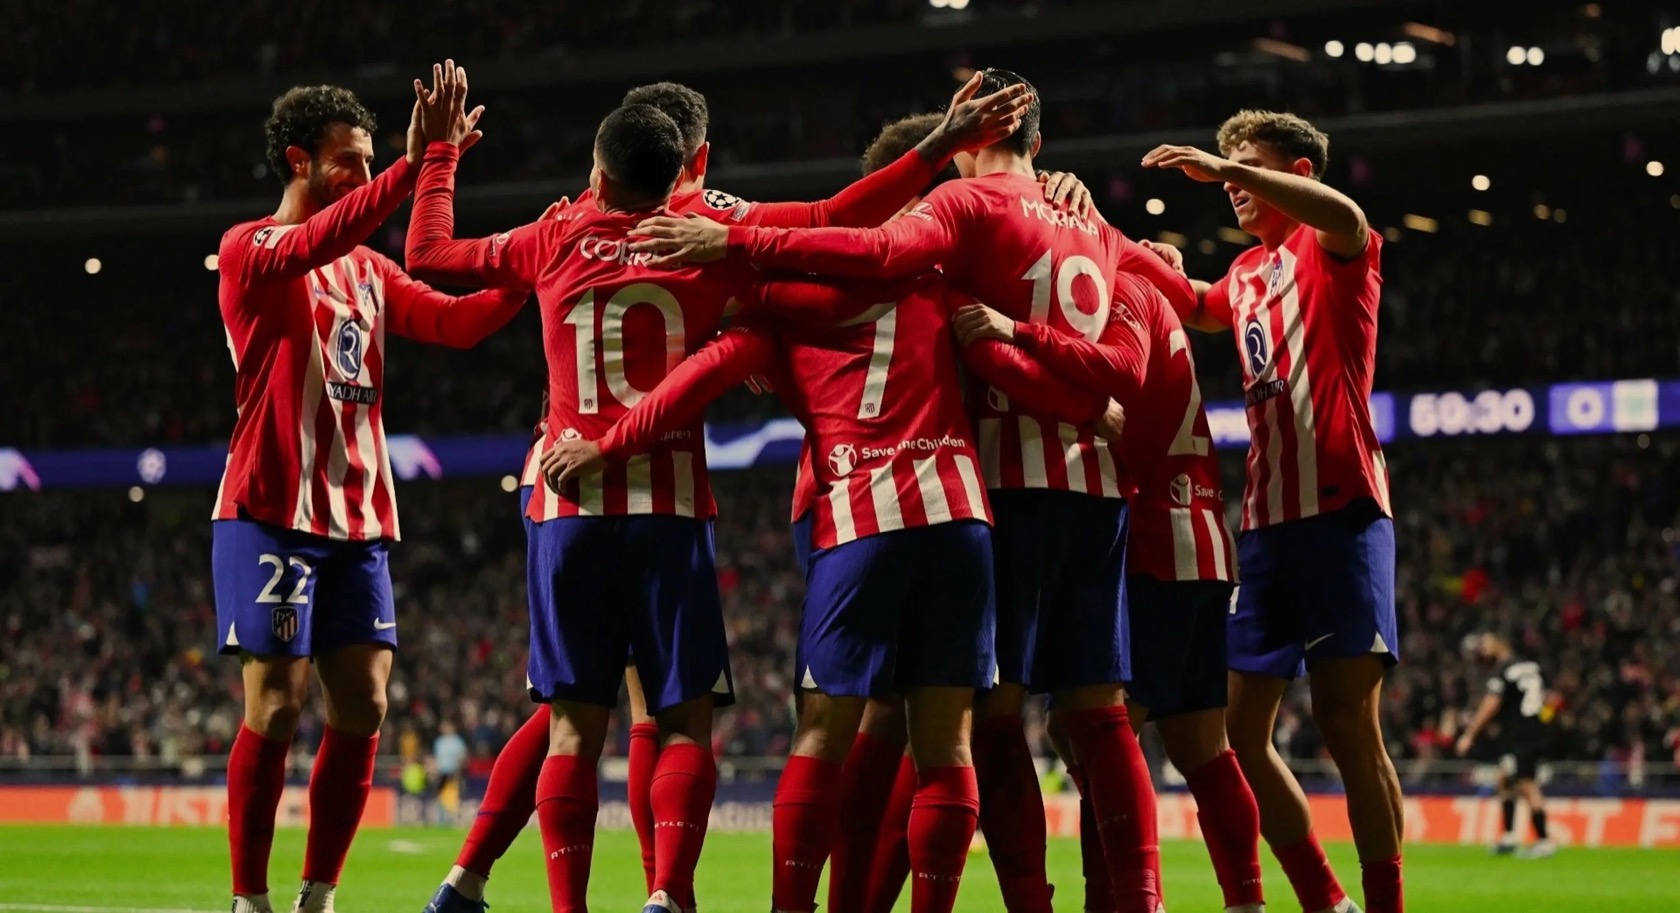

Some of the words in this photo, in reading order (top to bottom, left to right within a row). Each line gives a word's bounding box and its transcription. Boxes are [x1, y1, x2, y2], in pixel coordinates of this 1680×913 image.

[1020, 248, 1109, 344] 19
[562, 282, 685, 415] 10
[834, 301, 897, 420] 7
[365, 388, 378, 404] AIR
[1567, 387, 1605, 430] 0
[860, 446, 896, 460] Save
[1194, 483, 1214, 498] Save
[255, 553, 313, 604] 22
